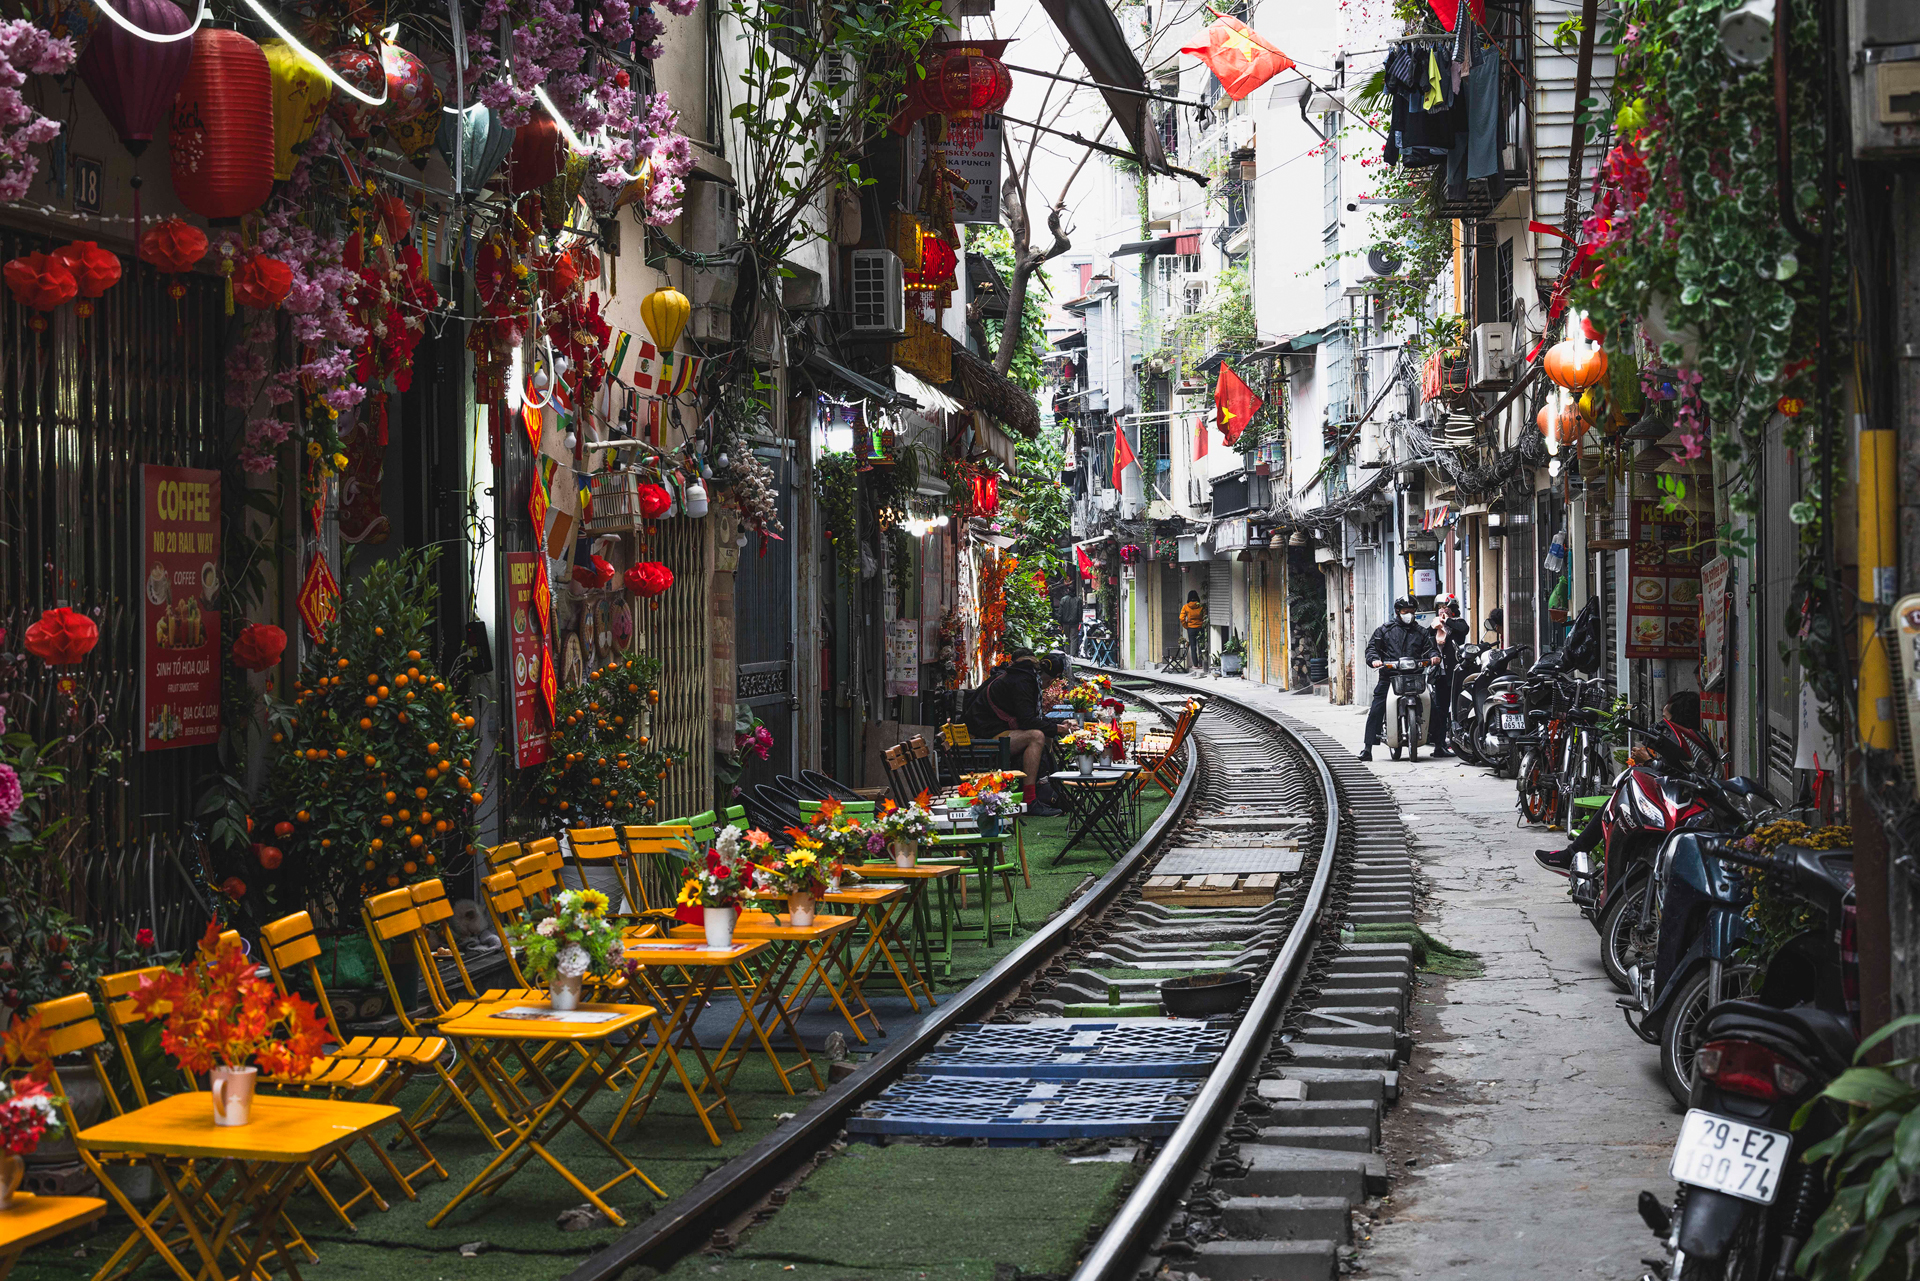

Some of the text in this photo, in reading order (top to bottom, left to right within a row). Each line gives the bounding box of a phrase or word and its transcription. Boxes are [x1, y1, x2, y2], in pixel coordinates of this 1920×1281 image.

[81, 166, 98, 205] 18
[157, 480, 211, 522] COFFEE
[153, 531, 214, 554] NO 20 RAIL WAY
[173, 571, 196, 585] COFFEE
[510, 562, 528, 585] MENU
[156, 654, 210, 677] SINH TỐ HOA QUẢ
[167, 682, 200, 693] FRUIT SMOOTHIE
[183, 702, 219, 720] BIA CÁC LOẠI
[184, 726, 194, 736] BEER
[194, 726, 200, 736] OF
[206, 724, 217, 734] KINDS
[1696, 1120, 1776, 1162] 29-E2
[1684, 1149, 1770, 1198] 180.74
